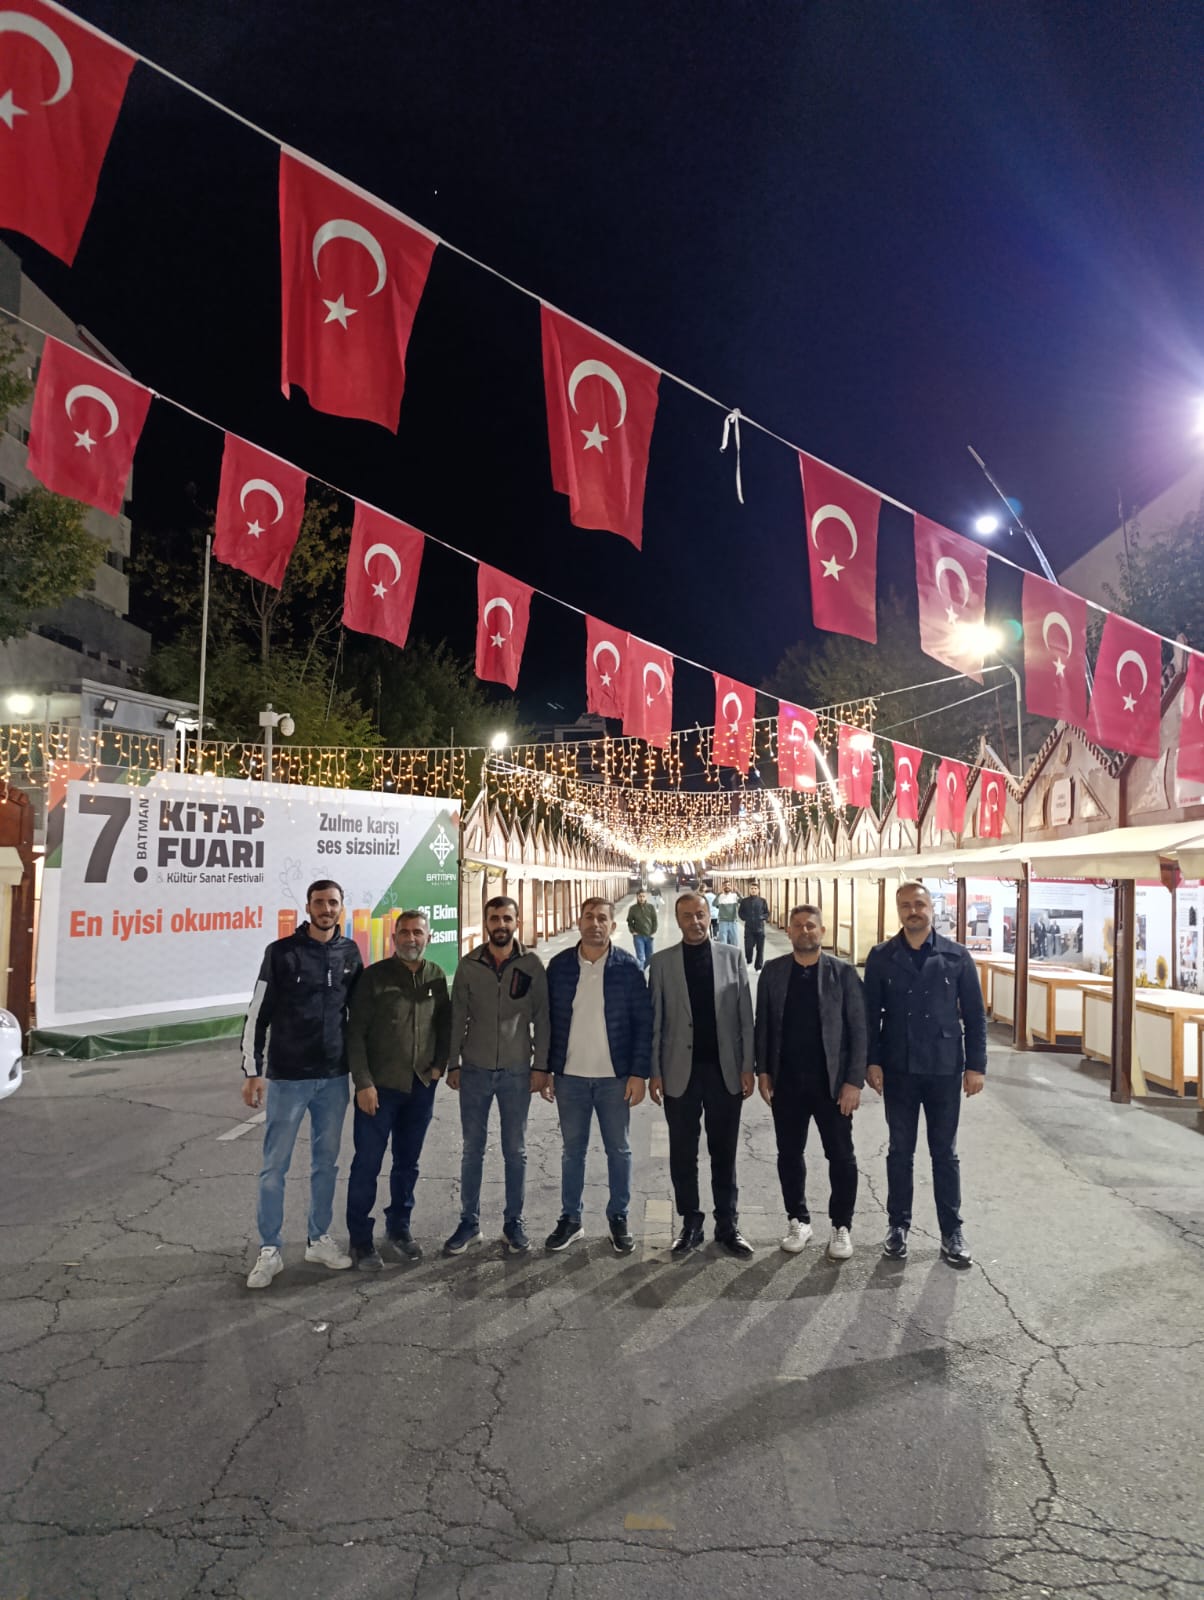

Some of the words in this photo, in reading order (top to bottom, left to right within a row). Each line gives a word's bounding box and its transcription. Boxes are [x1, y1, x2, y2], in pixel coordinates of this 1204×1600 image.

[137, 798, 150, 860] BATMAN
[320, 812, 363, 833] Zulme
[367, 815, 399, 839] karşı
[158, 837, 264, 868] FUARI
[317, 839, 342, 854] ses
[346, 837, 400, 856] sizsiniz!
[167, 871, 197, 883] Kültür
[199, 872, 226, 883] Sanat
[228, 872, 264, 883] Festivali
[69, 910, 102, 938] En
[112, 908, 163, 942] iyisi
[170, 905, 264, 933] okumak!
[433, 904, 458, 920] Ekim
